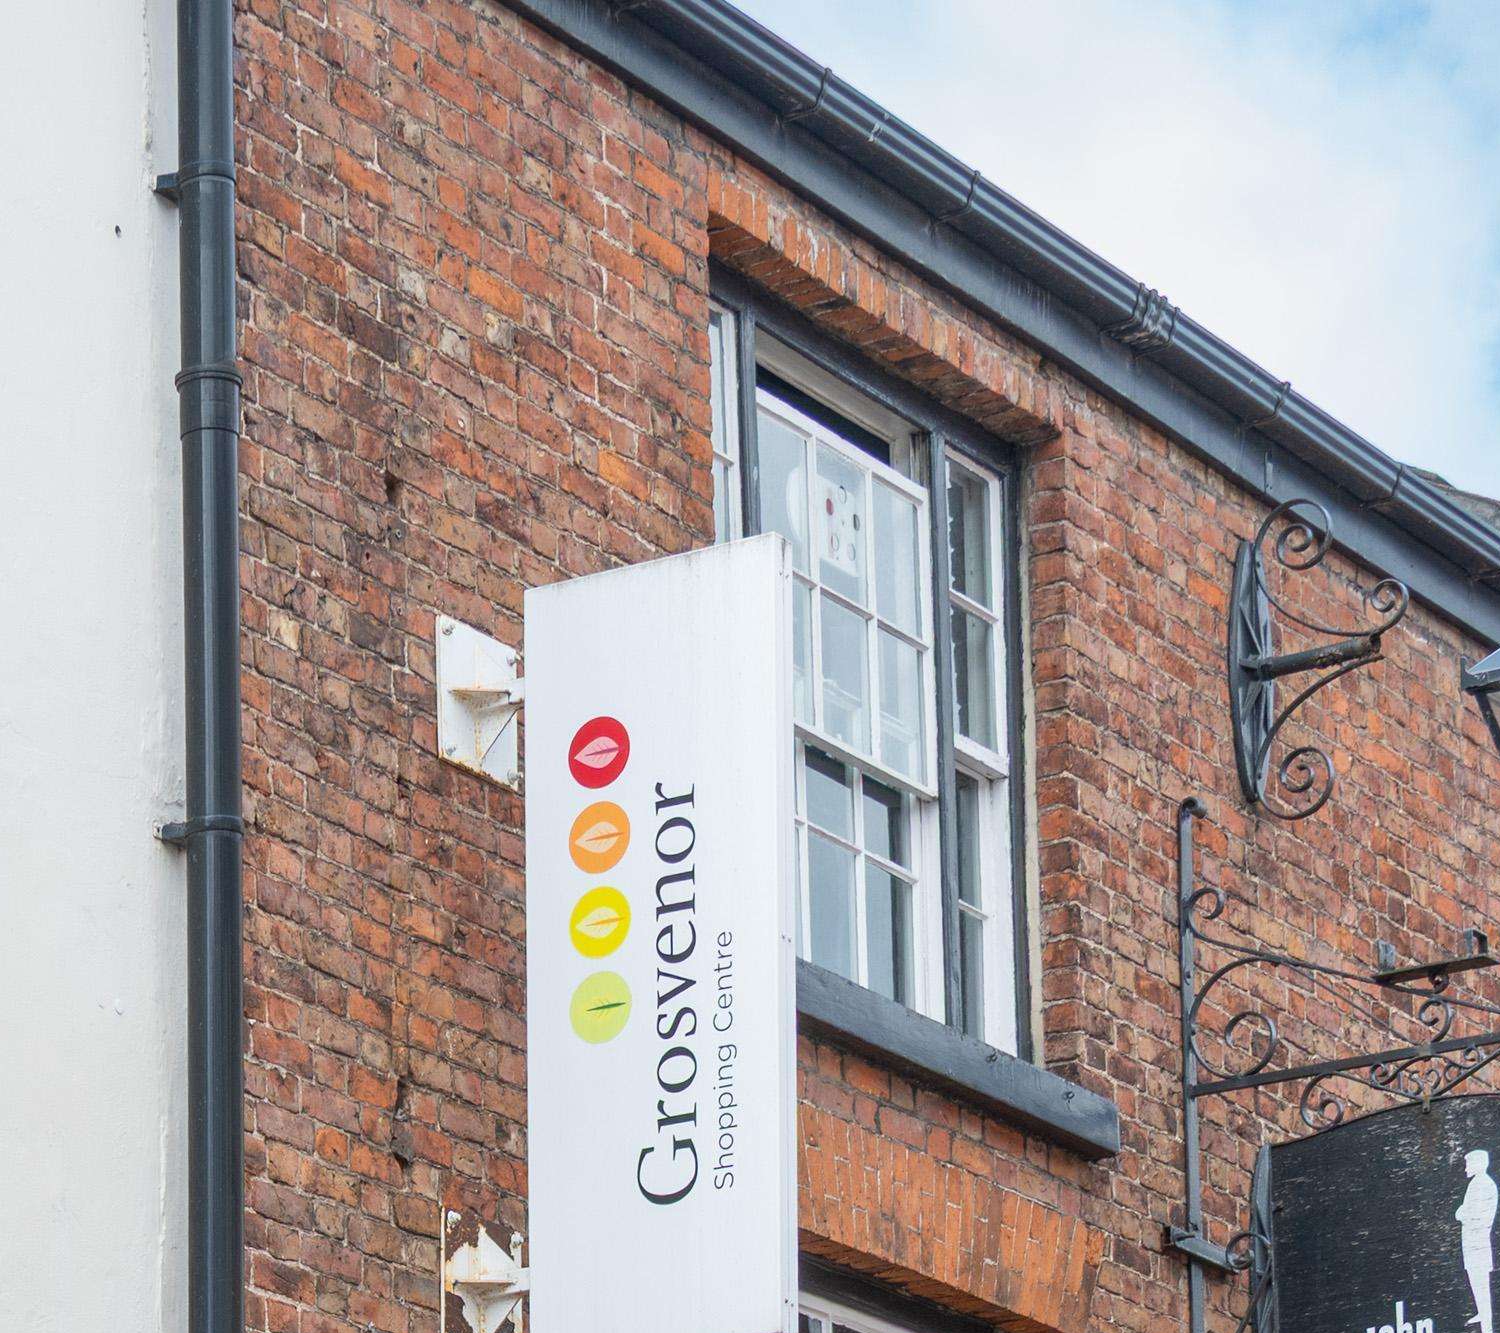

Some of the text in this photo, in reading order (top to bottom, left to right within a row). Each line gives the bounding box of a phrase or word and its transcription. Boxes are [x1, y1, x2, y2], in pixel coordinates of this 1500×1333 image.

[637, 782, 699, 1206] Grosvenor
[713, 929, 737, 1190] Shopping Centre
